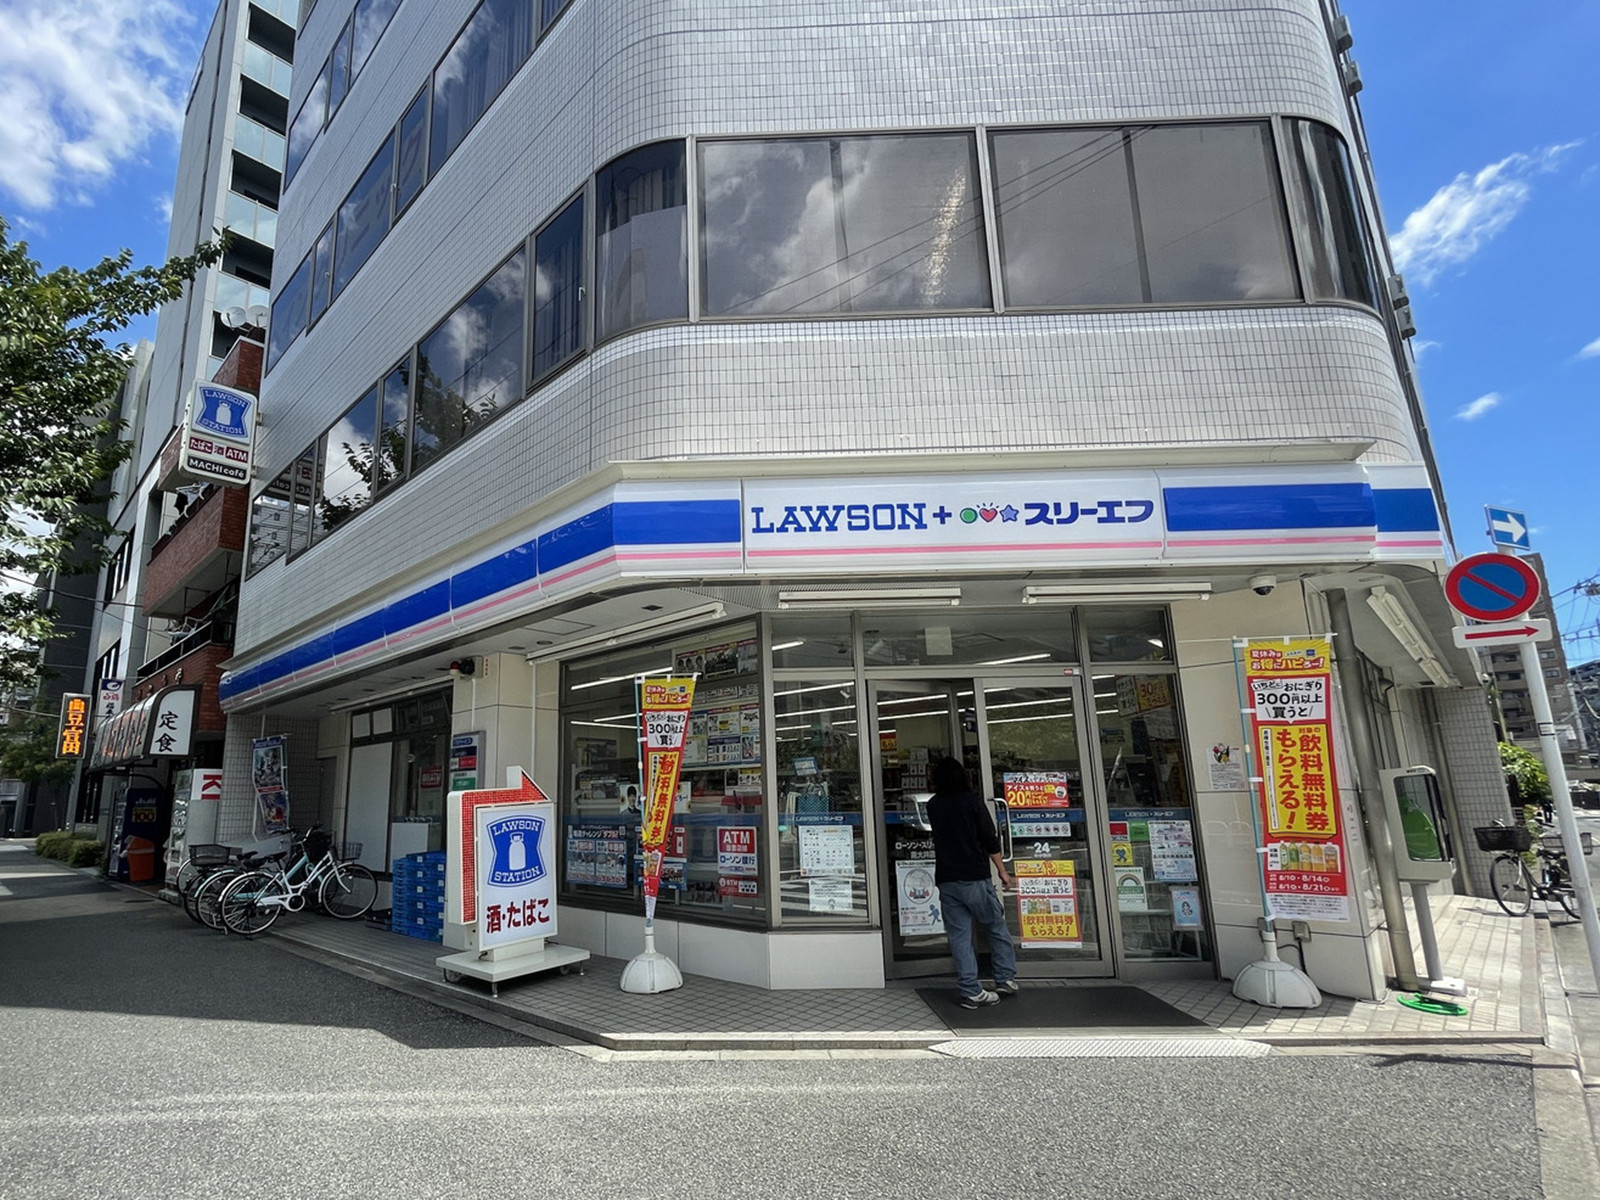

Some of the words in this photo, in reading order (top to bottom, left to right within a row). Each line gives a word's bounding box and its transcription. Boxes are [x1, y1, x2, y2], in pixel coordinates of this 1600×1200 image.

[201, 418, 243, 435] STATION
[190, 438, 212, 453] たばこ
[226, 447, 248, 462] ATM
[751, 503, 927, 534] LAWSON
[1024, 500, 1154, 526] スリーエフ
[1284, 681, 1322, 692] おにぎり
[1257, 693, 1323, 705] 300円以上
[155, 711, 179, 753] 定食
[1276, 729, 1300, 830] もらえる!
[1299, 734, 1329, 831] 飲料無料券
[492, 820, 540, 836] LAWSON
[723, 831, 750, 844] ATM
[1033, 842, 1051, 853] 24
[720, 855, 755, 866] ローソン銀行
[494, 866, 541, 882] STATION
[486, 898, 550, 934] 酒・たばこ
[1027, 915, 1074, 926] 飲料無料券
[1030, 925, 1070, 936] もらえる!
